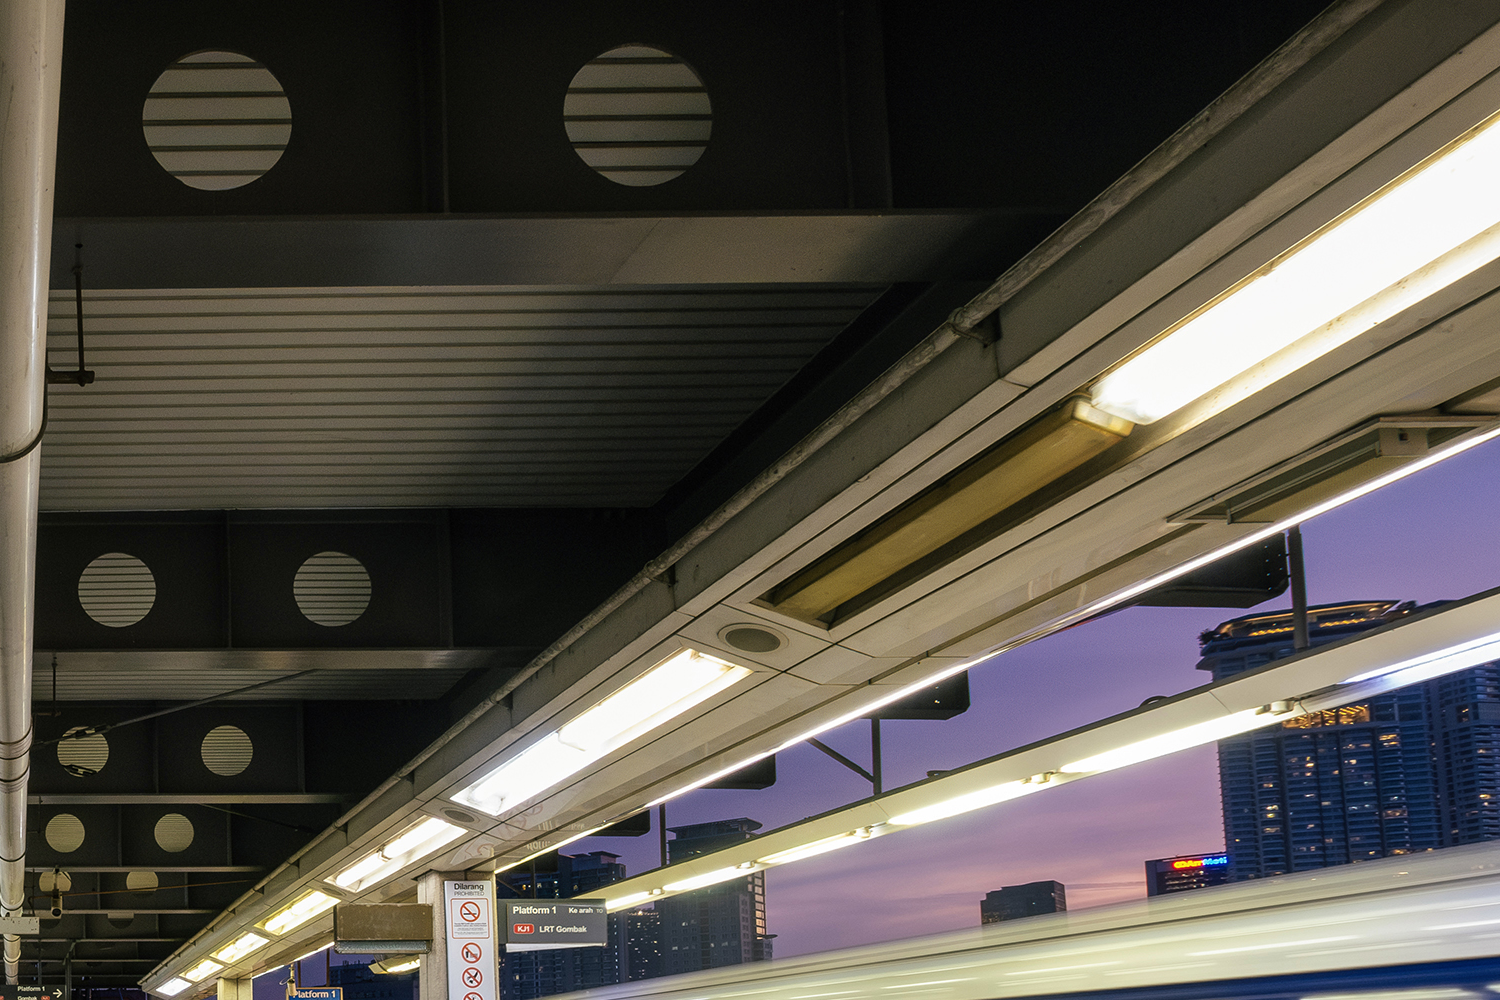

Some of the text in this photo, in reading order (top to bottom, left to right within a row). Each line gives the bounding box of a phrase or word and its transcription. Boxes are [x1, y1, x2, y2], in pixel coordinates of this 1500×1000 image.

[454, 883, 484, 891] Dilarang
[512, 906, 557, 914] Platform 1
[539, 925, 554, 933] LRT
[556, 925, 587, 933] Gombak
[331, 990, 335, 998] 1
